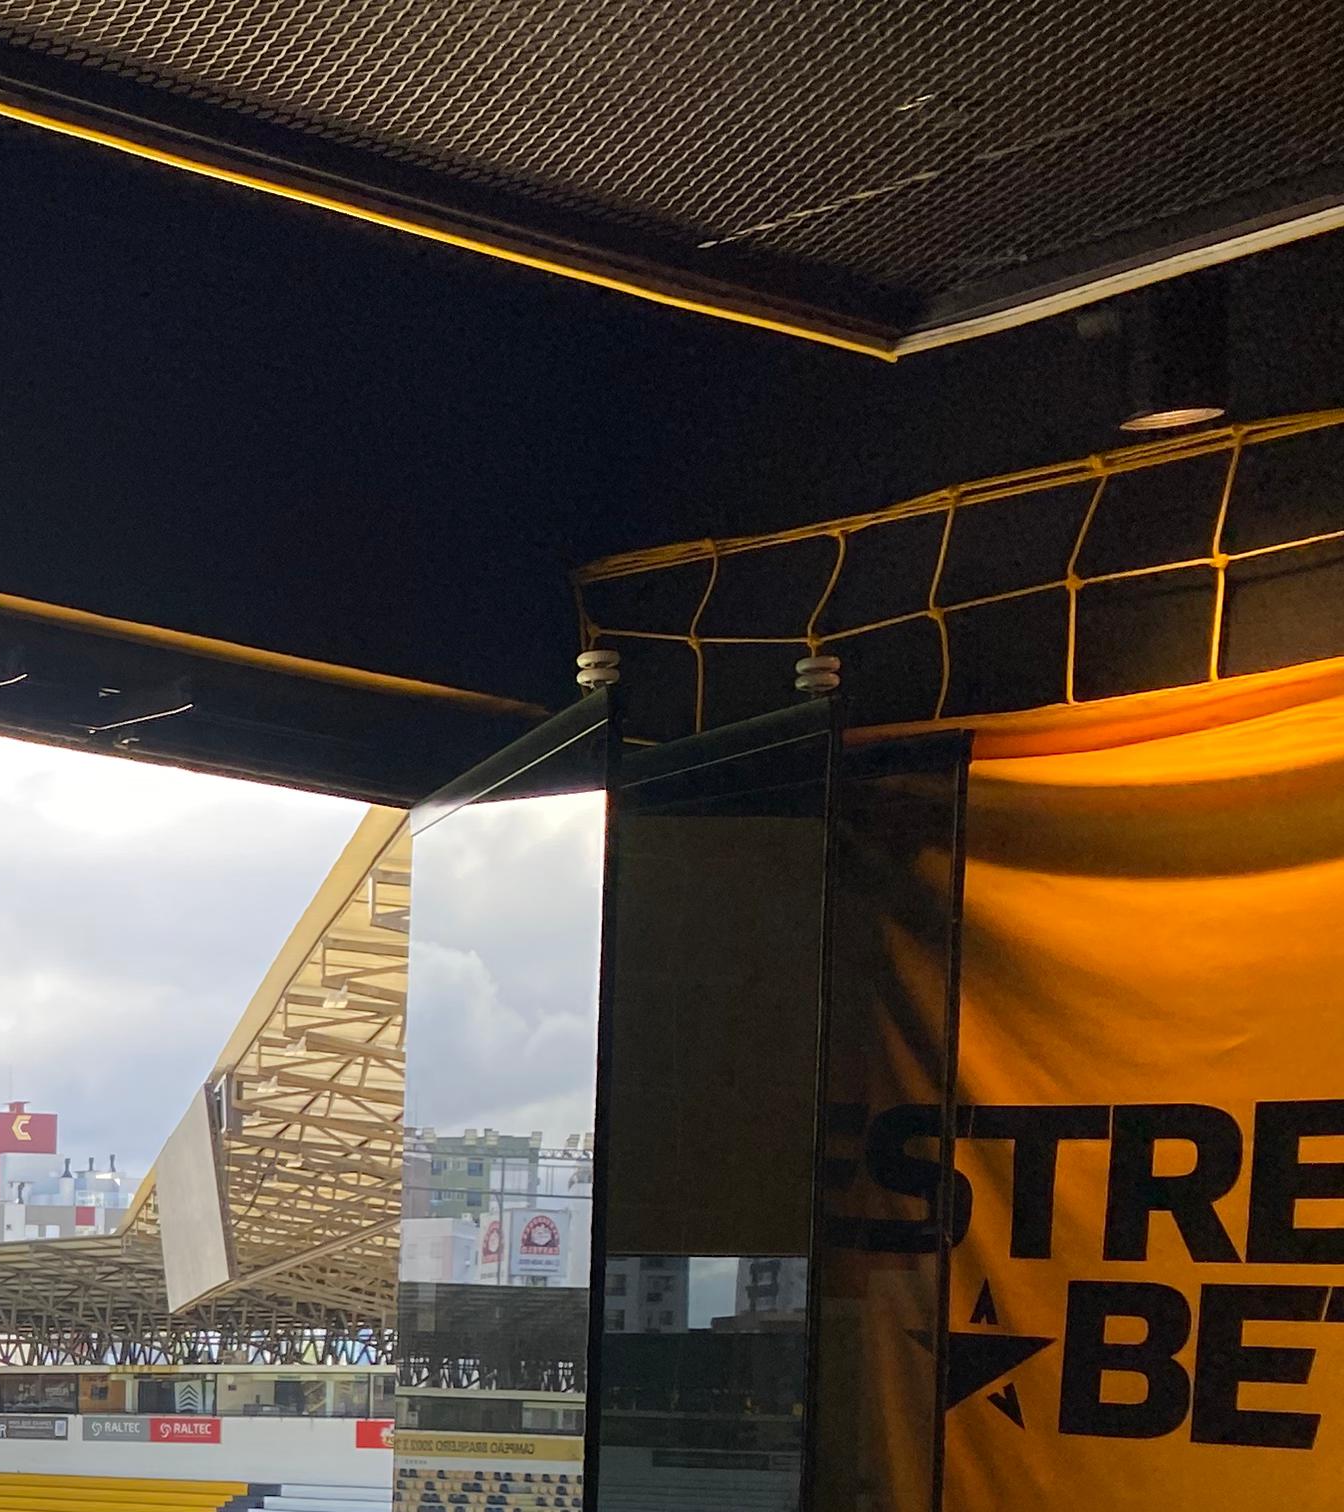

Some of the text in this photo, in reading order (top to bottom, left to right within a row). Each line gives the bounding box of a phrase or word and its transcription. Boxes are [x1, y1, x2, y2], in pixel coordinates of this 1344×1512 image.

[1058, 1280, 1344, 1450] BE
[105, 1422, 141, 1433] RALTEC
[173, 1423, 212, 1434] RALTEC
